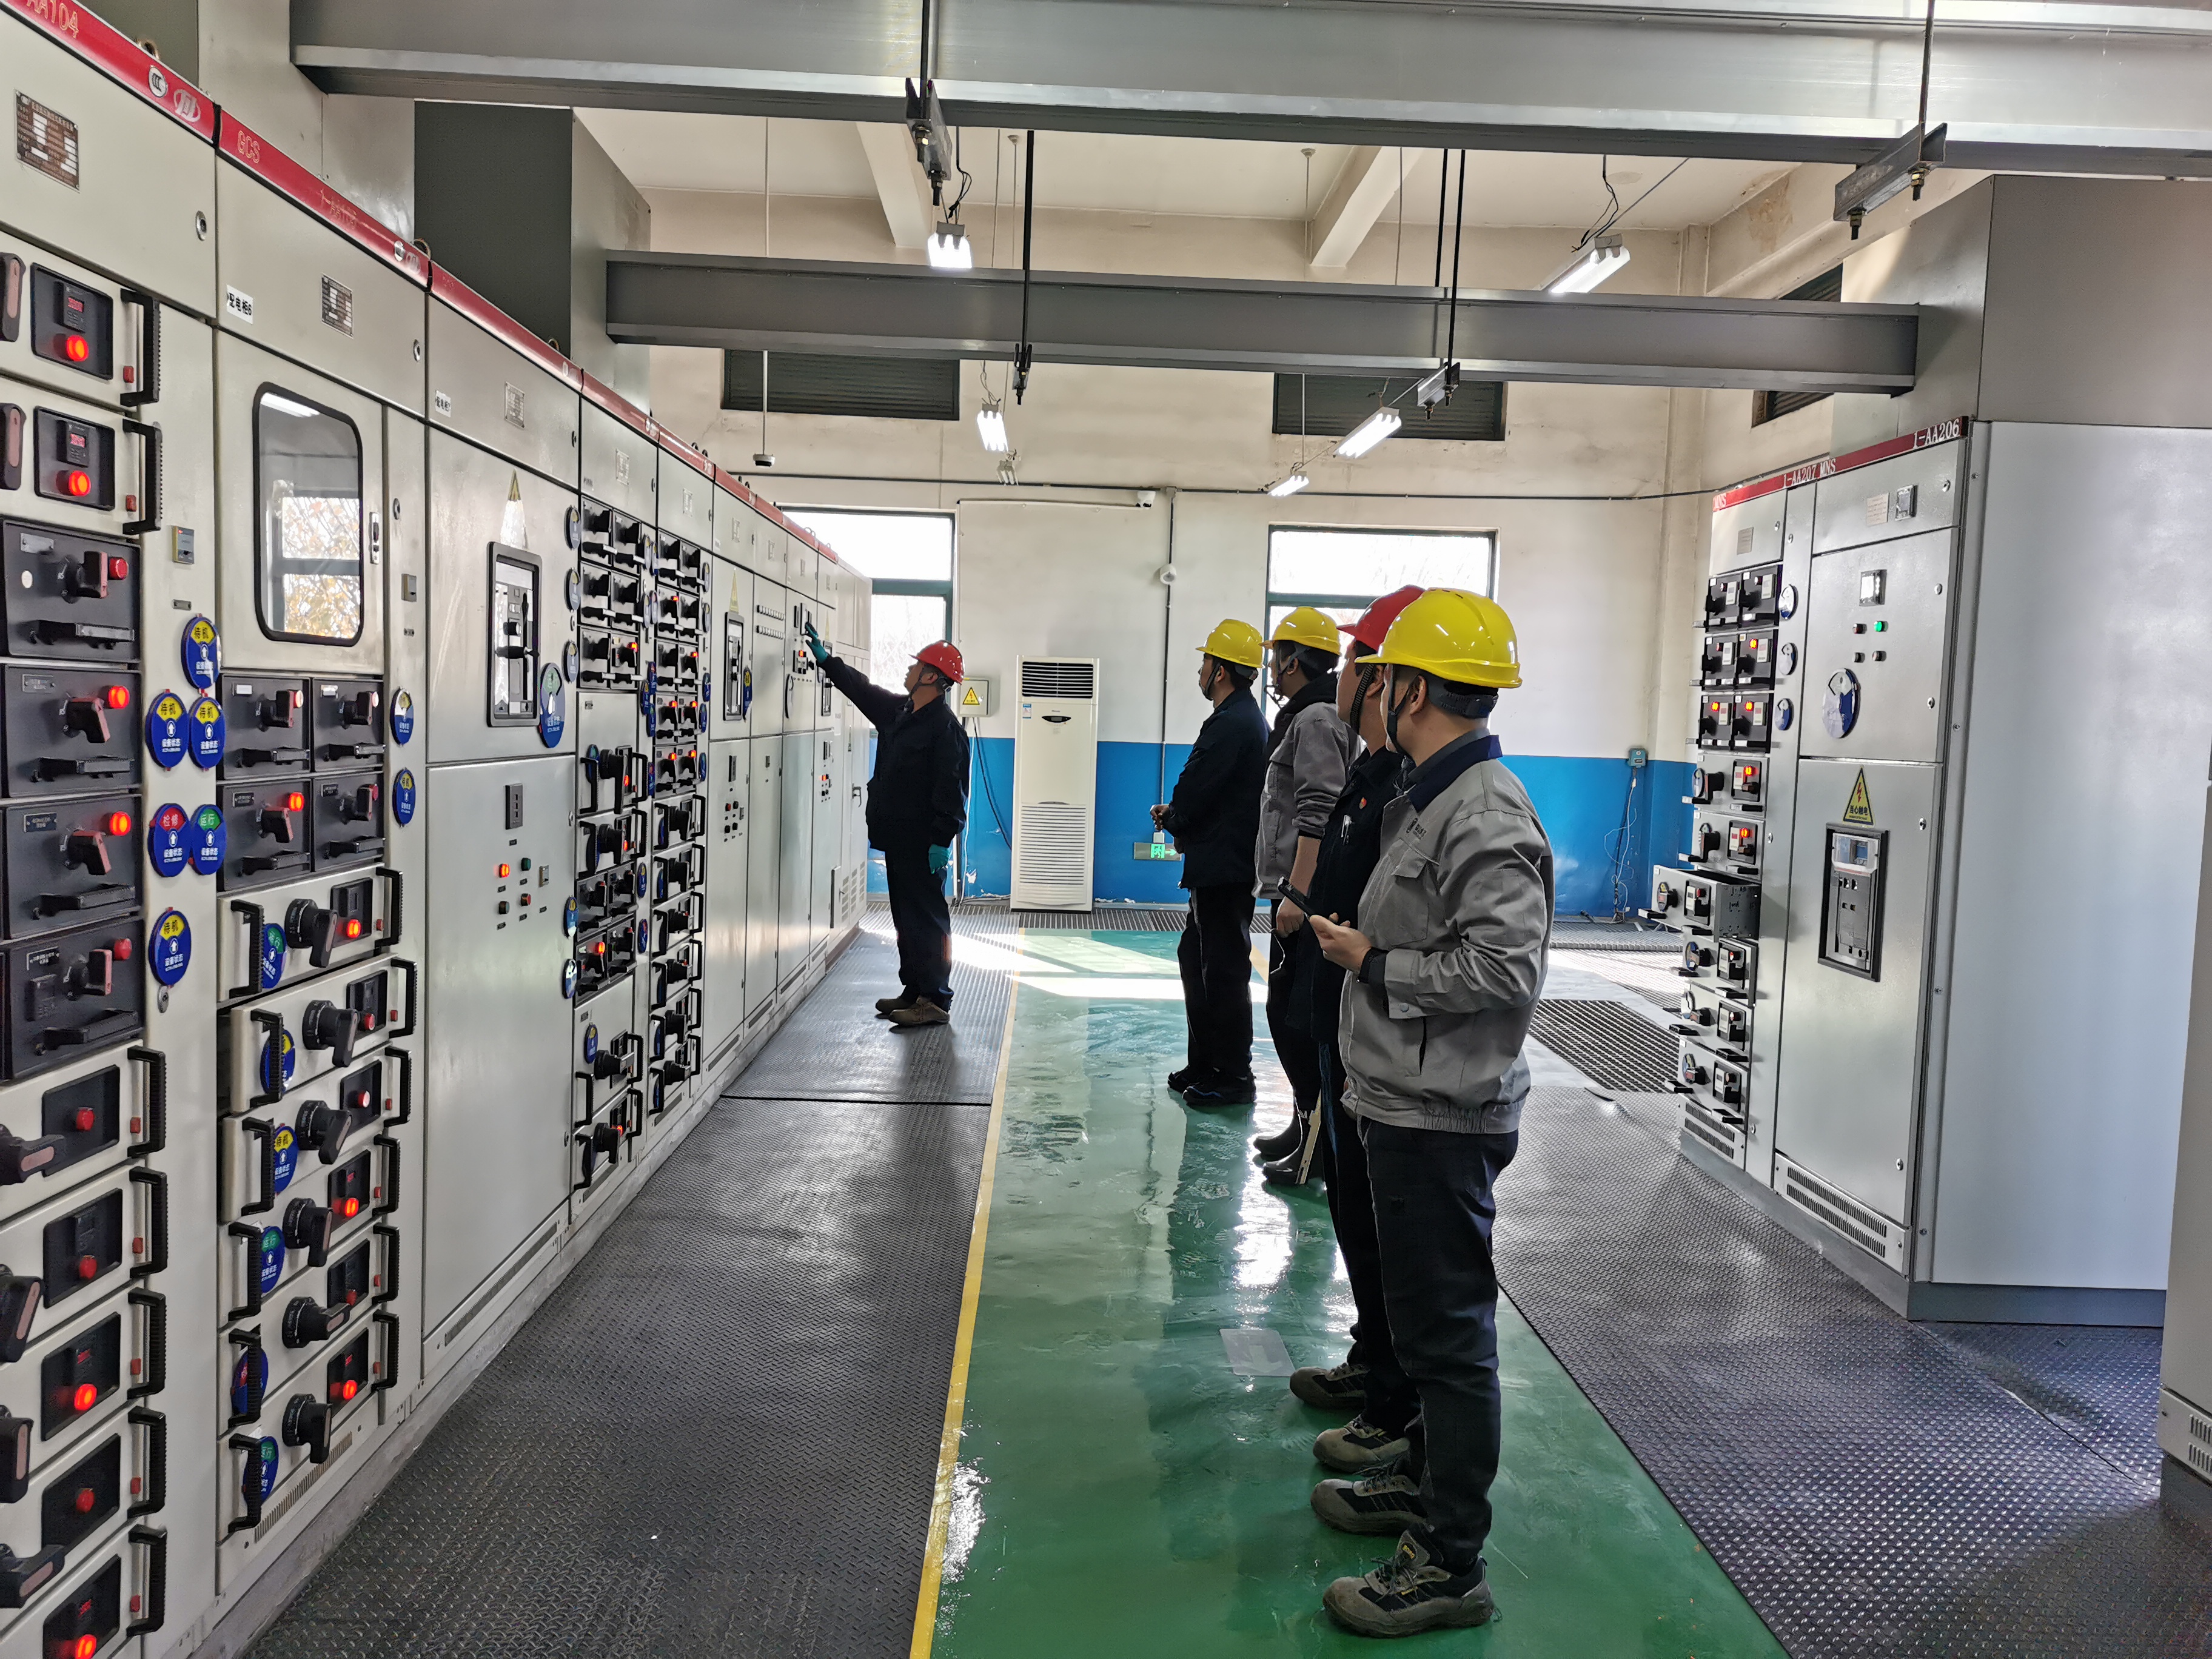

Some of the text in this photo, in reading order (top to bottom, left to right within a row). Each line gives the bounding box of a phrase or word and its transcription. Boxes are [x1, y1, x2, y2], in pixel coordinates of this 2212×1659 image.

[237, 130, 261, 164] GCS
[1912, 418, 1960, 449] 1-AA206
[1783, 464, 1817, 488] 1-AA207
[1819, 458, 1837, 478] MNS
